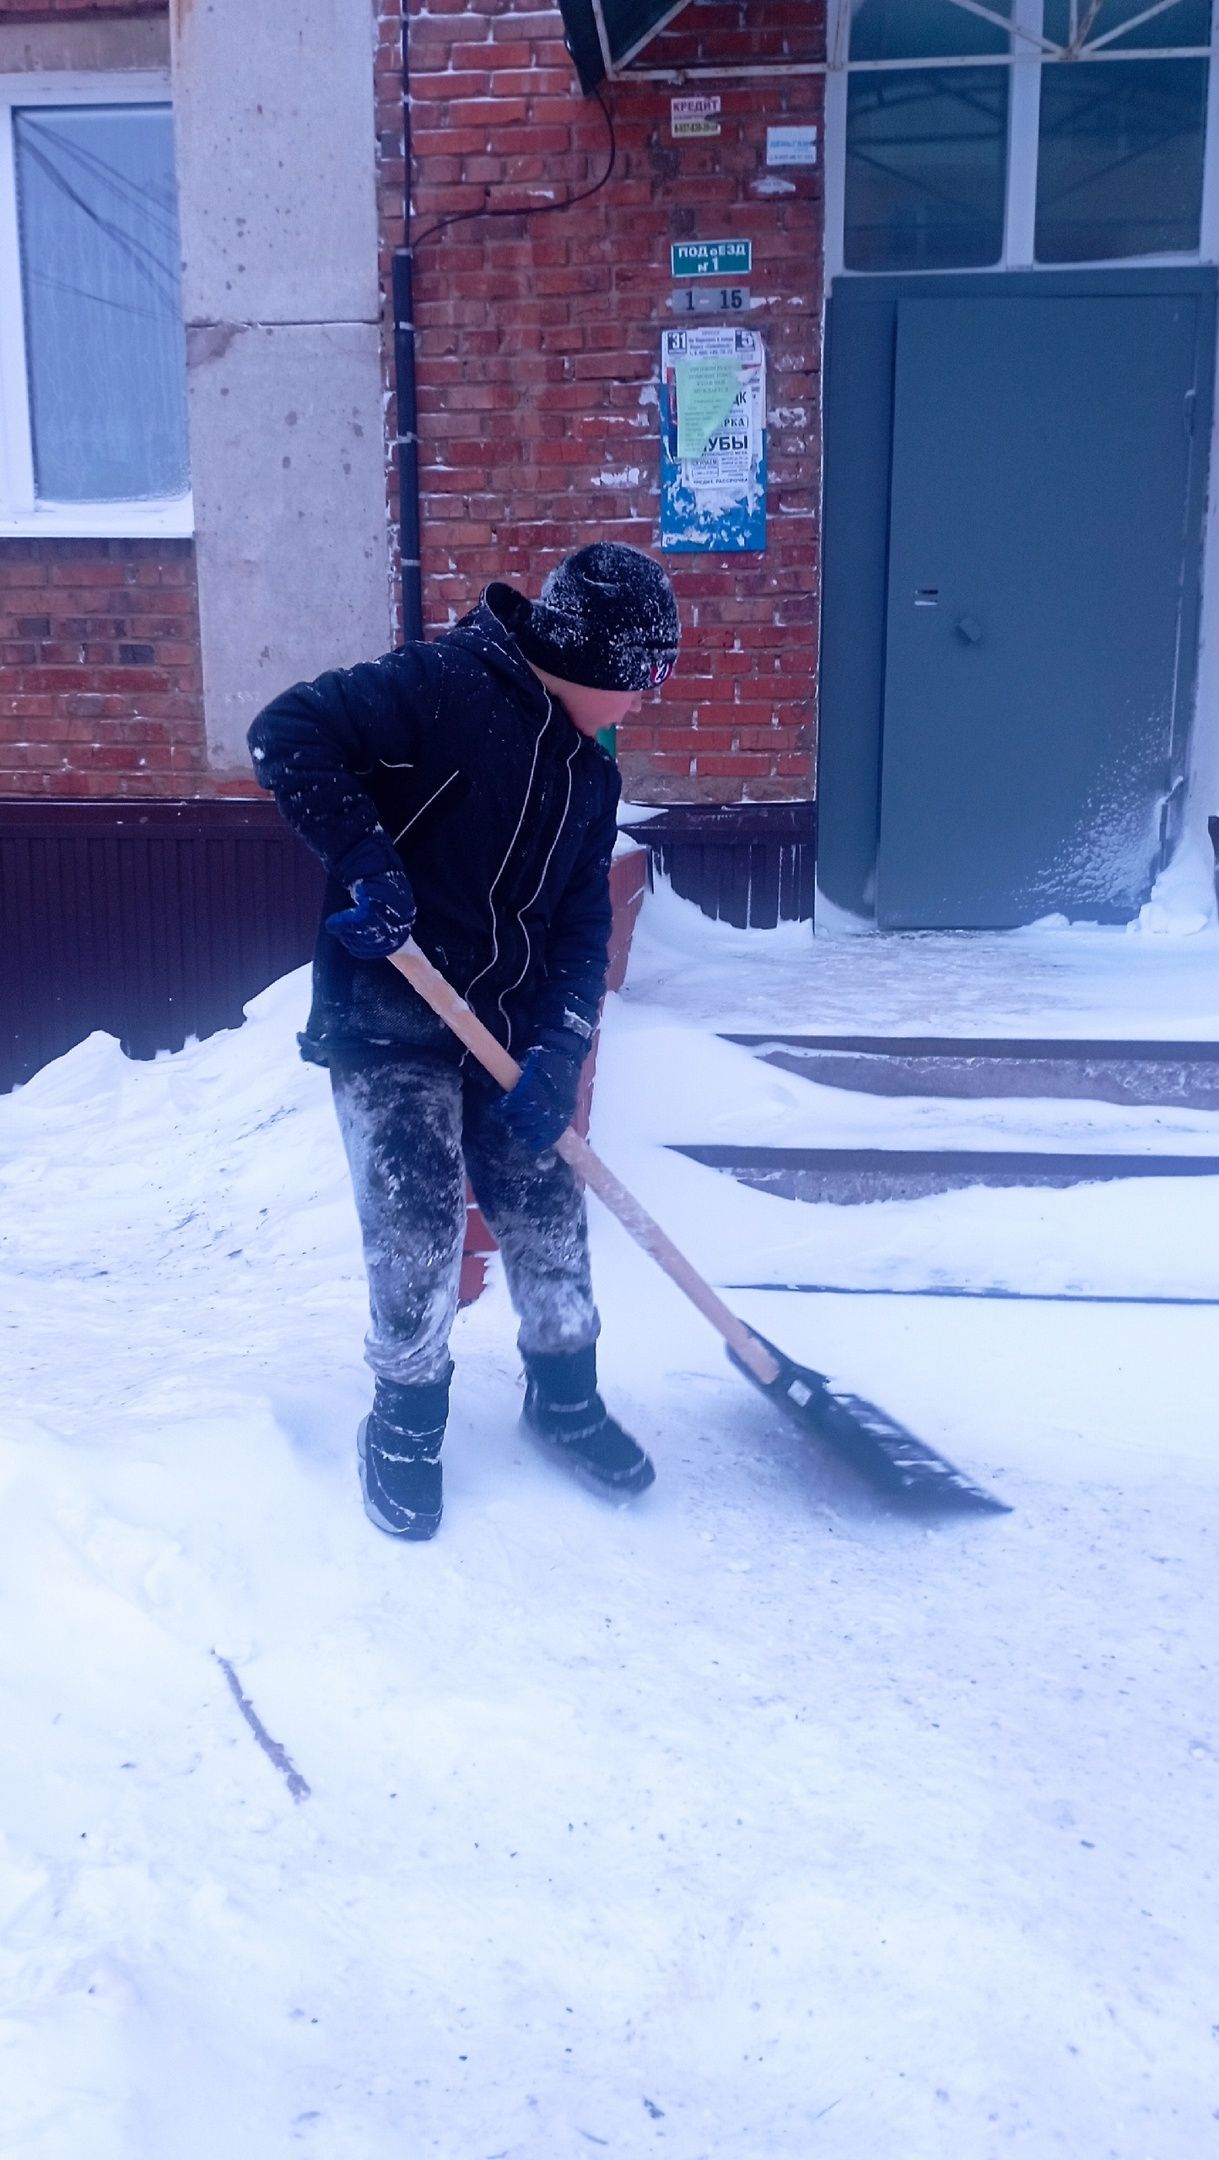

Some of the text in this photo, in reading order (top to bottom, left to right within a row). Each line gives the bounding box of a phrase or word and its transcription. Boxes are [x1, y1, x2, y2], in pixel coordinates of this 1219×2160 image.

[673, 100, 717, 112] КРЕДИТ
[685, 290, 695, 311] 1
[720, 289, 742, 309] 15
[704, 435, 748, 452] УБЫ
